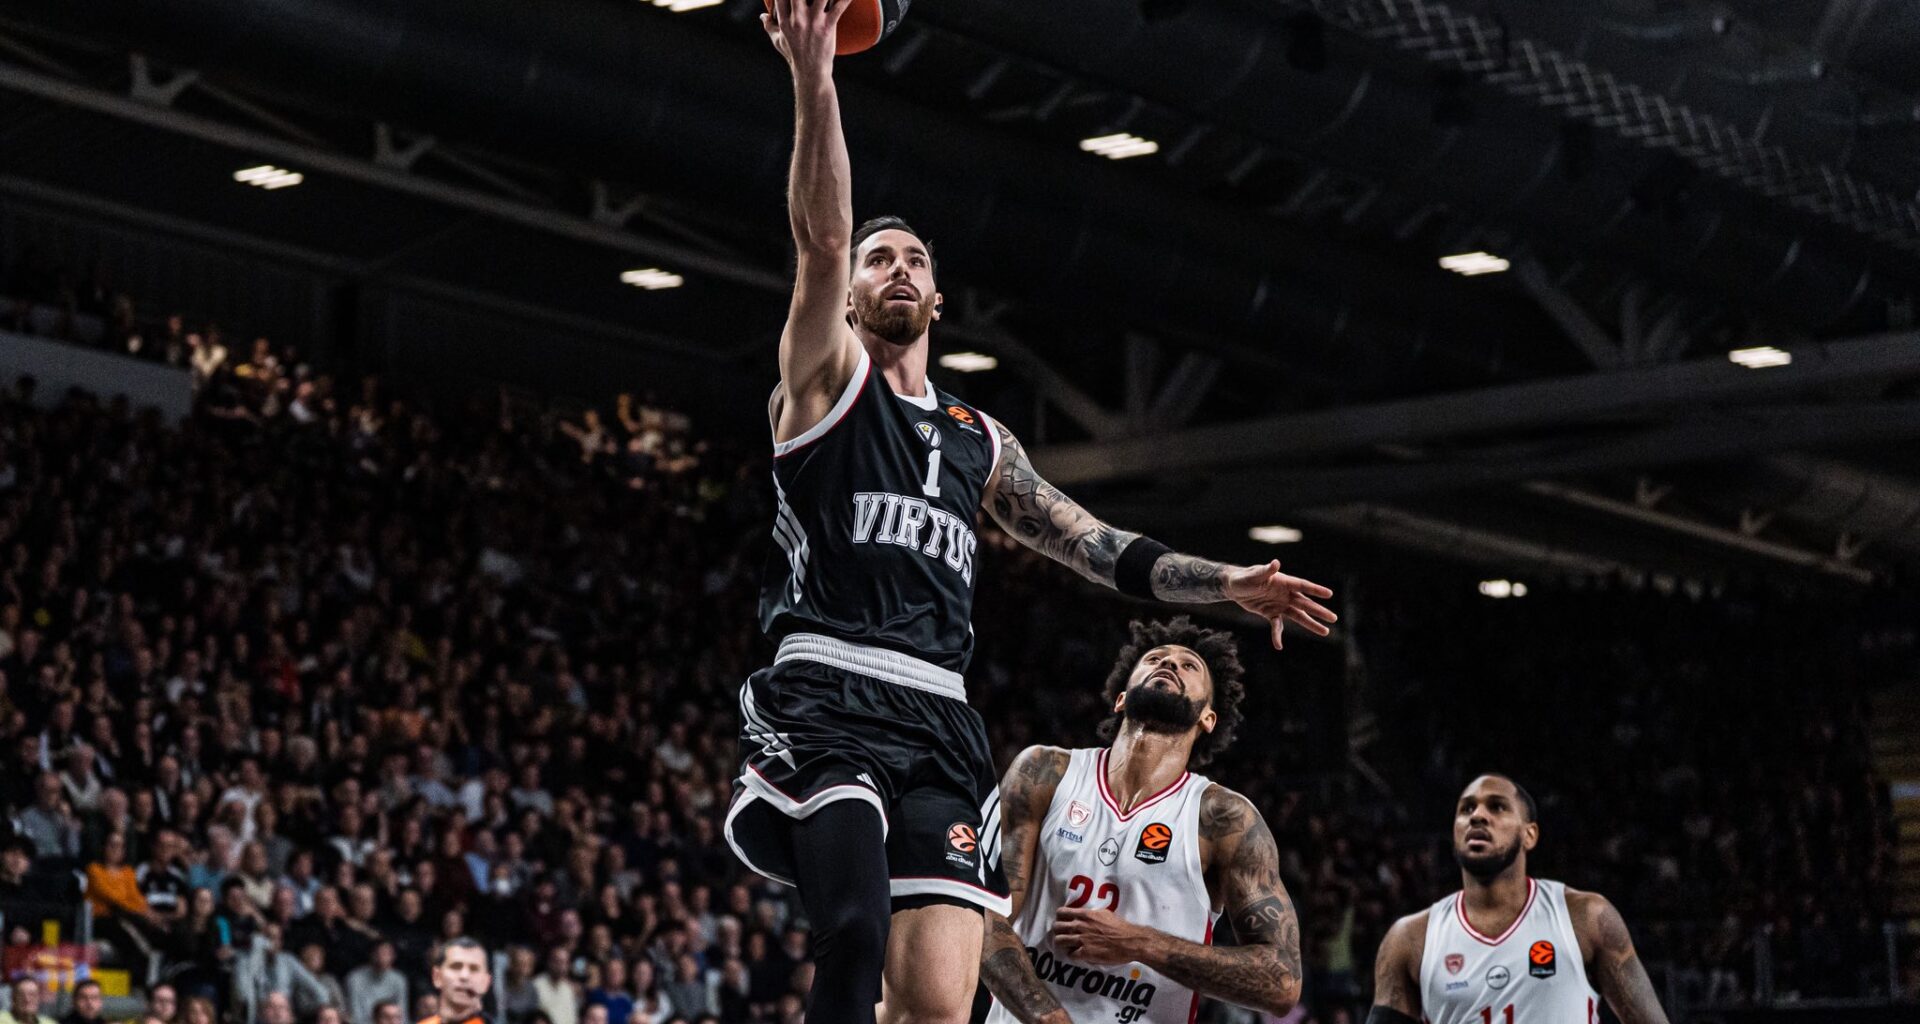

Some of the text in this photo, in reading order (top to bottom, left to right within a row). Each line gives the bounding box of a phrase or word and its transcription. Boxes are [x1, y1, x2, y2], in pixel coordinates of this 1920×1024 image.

[922, 449, 941, 498] 1
[853, 491, 978, 588] VIRTUS
[1065, 875, 1120, 912] 22
[1115, 1005, 1147, 1024] .gr
